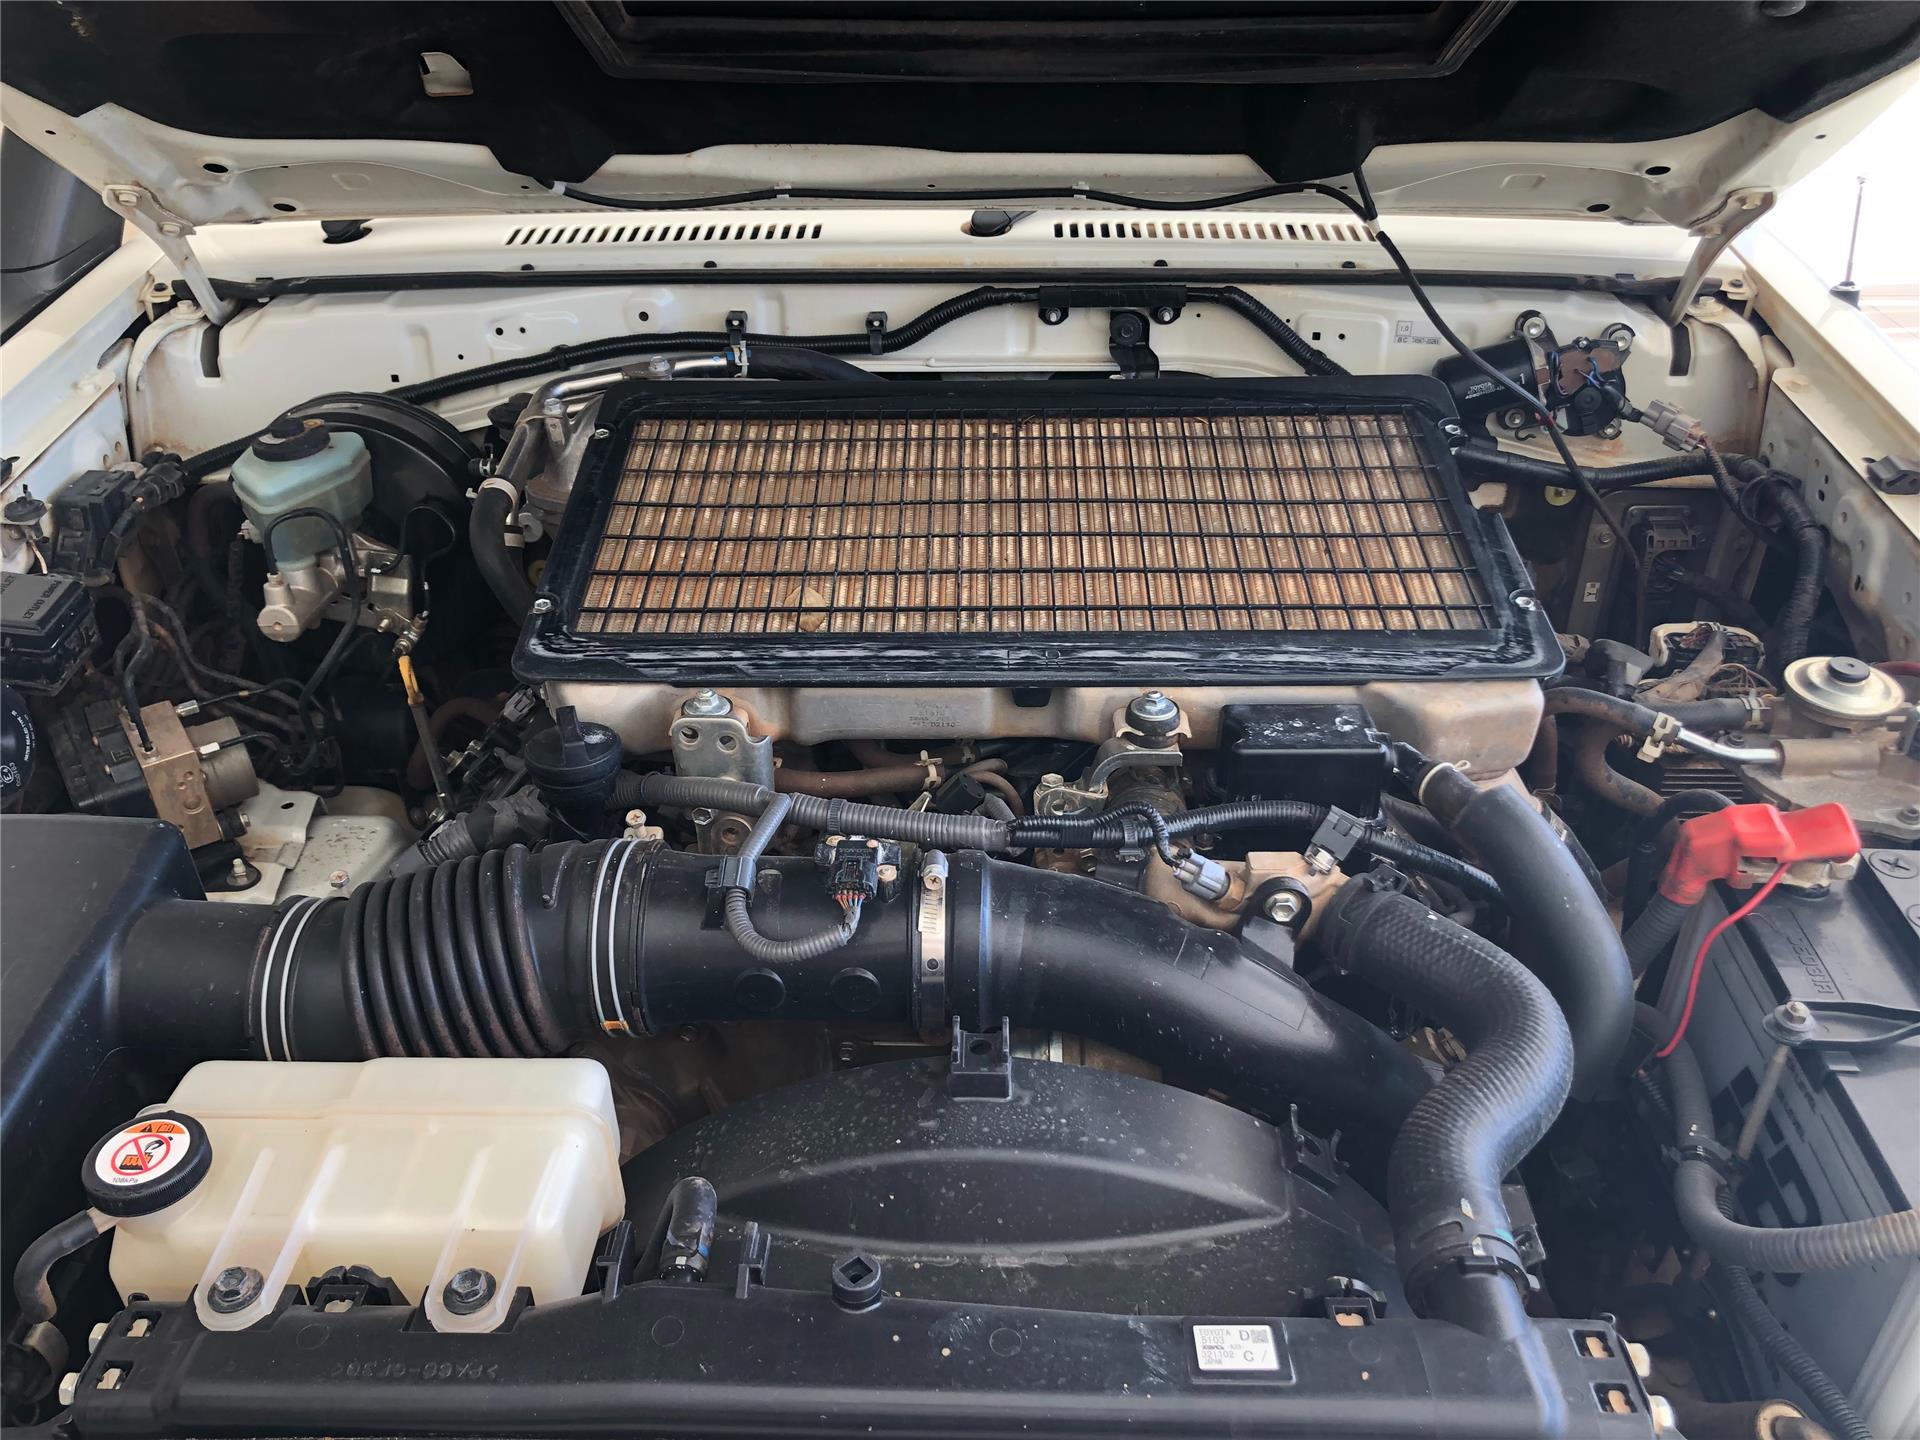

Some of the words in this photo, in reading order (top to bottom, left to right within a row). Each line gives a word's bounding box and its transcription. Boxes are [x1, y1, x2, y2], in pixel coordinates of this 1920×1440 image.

[1199, 1329, 1231, 1337] TOYOTA
[1239, 1329, 1250, 1341] D
[1201, 1335, 1225, 1345] 5103
[1243, 1350, 1255, 1362] C
